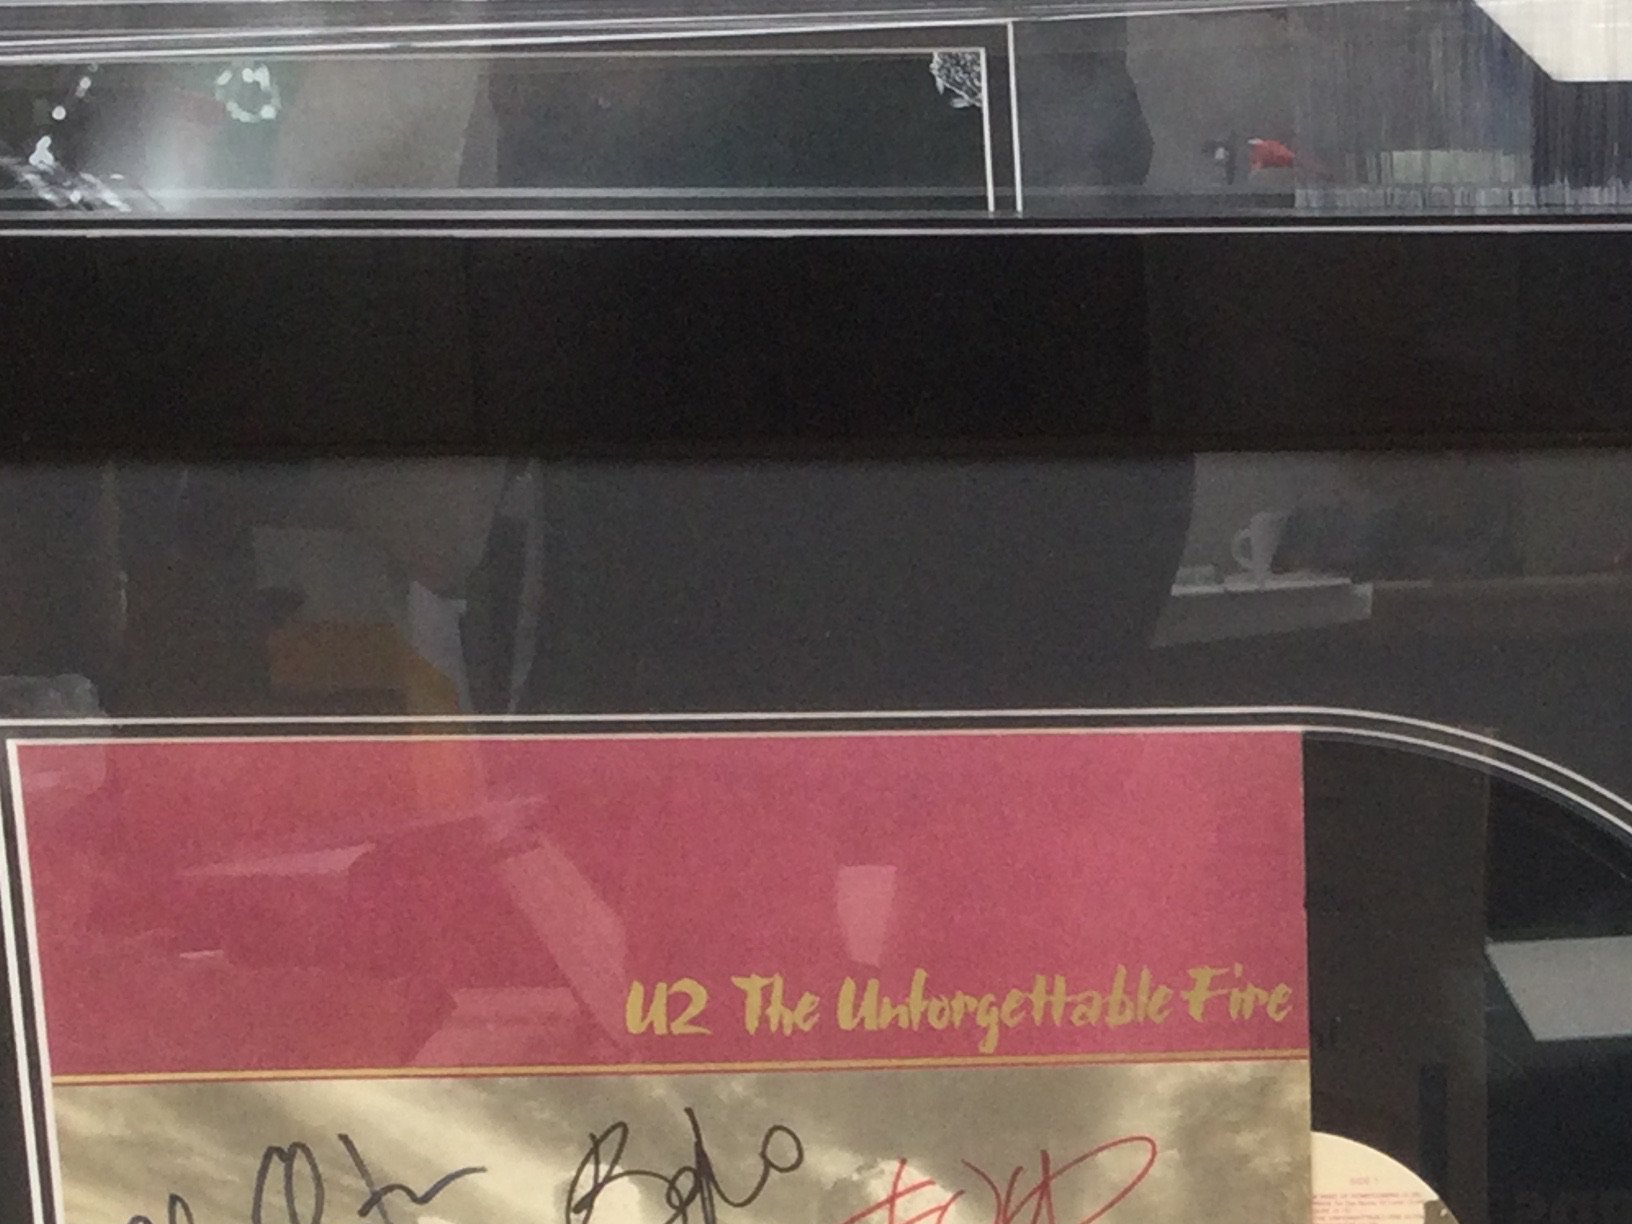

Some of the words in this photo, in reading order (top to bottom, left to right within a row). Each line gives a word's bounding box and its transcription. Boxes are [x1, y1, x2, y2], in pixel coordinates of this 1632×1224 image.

[625, 976, 712, 1036] U2
[730, 972, 821, 1036] The
[835, 964, 1173, 1053] Unforgettable
[1180, 962, 1293, 1024] Fire
